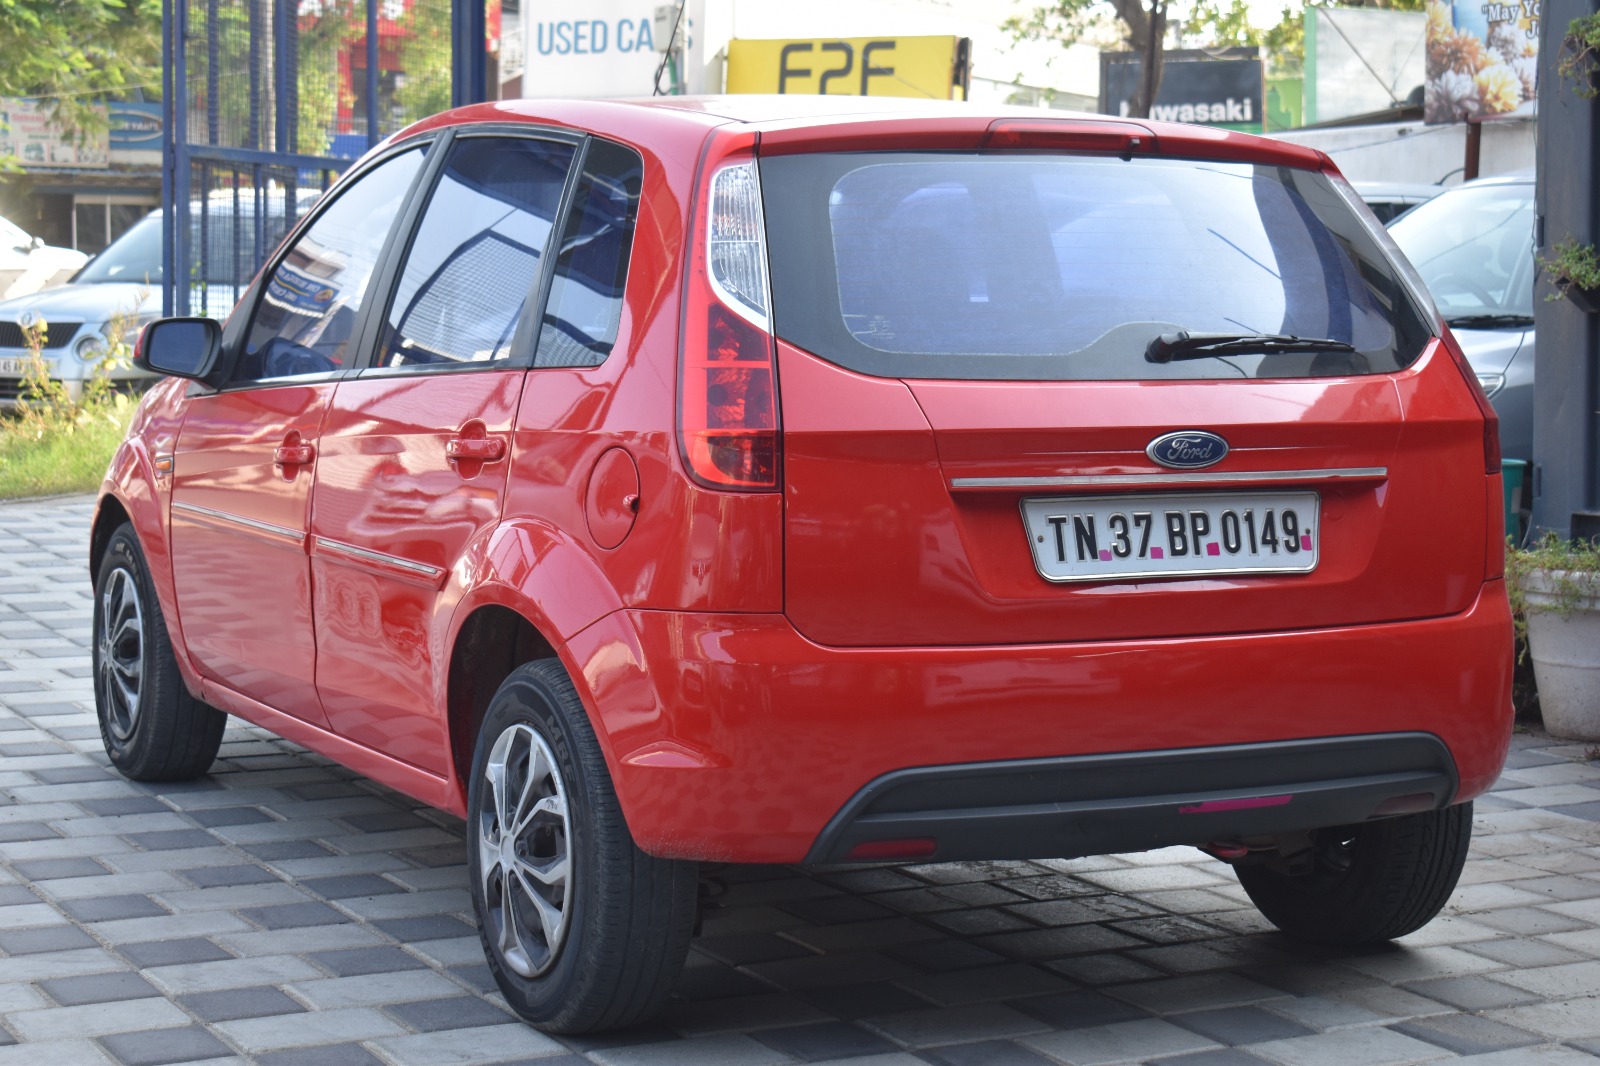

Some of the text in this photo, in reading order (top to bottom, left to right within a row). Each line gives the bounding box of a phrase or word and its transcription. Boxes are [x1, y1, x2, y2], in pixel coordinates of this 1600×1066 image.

[537, 18, 693, 56] USED CA
[778, 40, 896, 96] F2F
[1119, 97, 1253, 123] wasaki
[1167, 438, 1213, 460] Ford
[1047, 508, 1301, 562] TN 37 BP 0149
